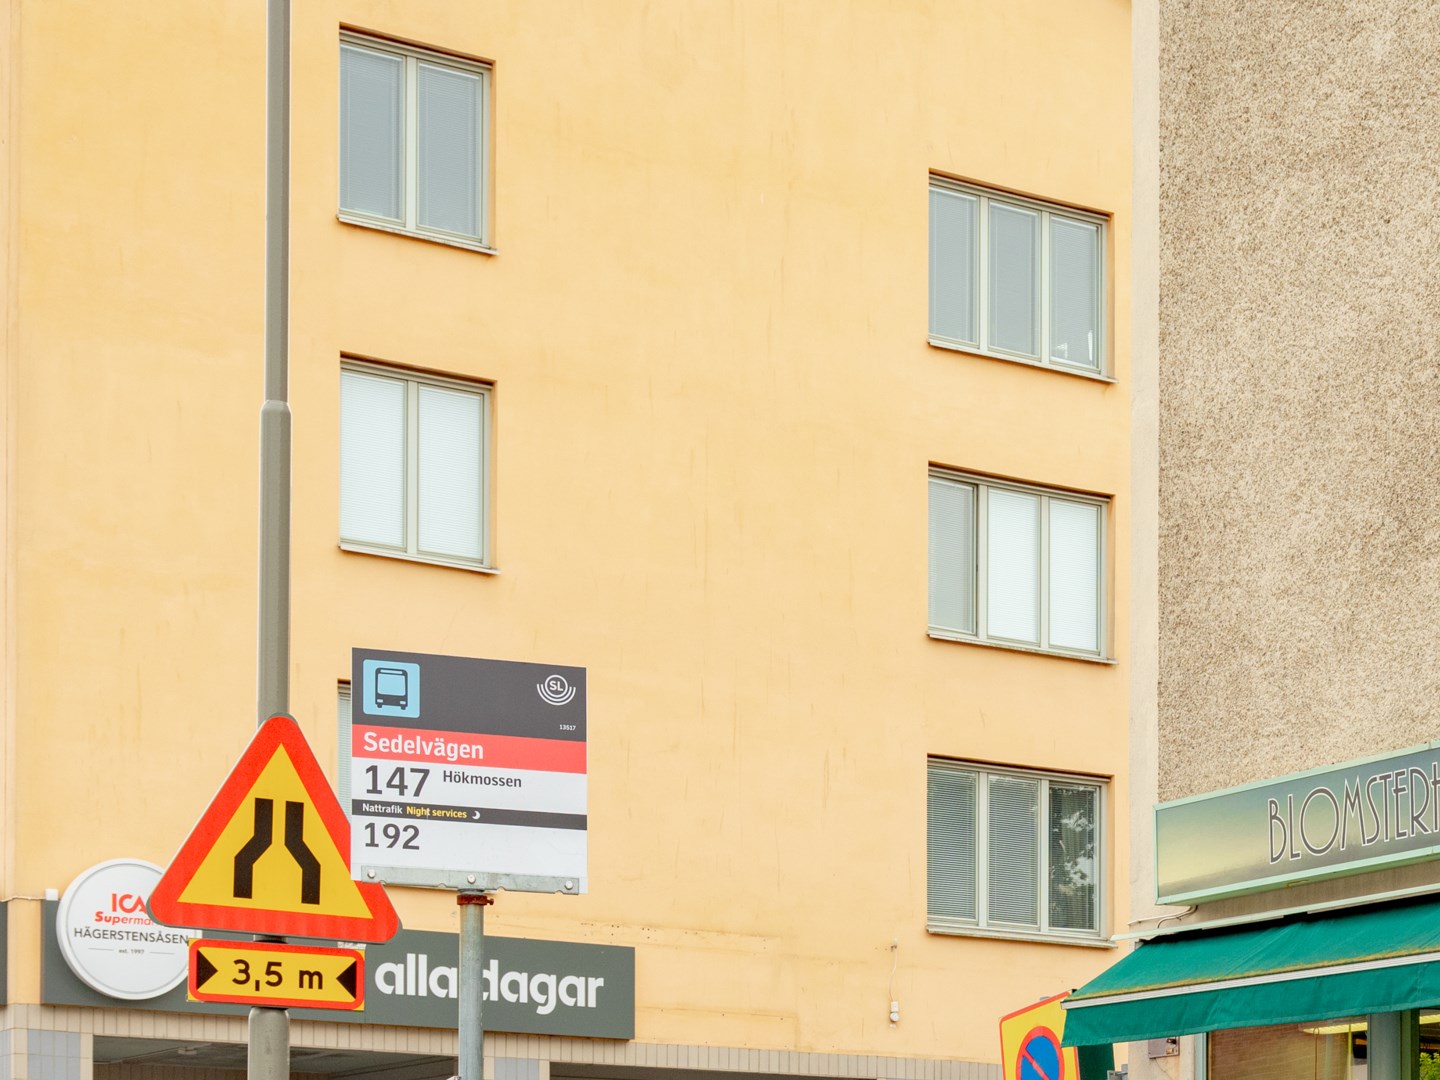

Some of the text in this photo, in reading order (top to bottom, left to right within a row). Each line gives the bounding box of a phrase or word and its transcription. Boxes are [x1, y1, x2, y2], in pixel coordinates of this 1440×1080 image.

[549, 680, 563, 692] SL
[363, 732, 484, 761] Sedelvägen
[365, 765, 430, 797] 147
[443, 770, 522, 788] Hökmossen
[362, 803, 467, 819] Nattrafik Night services
[364, 822, 420, 850] 192
[111, 893, 147, 914] ICA
[73, 926, 189, 945] HÄGERSTENSÅSEN
[232, 959, 323, 992] 3,5 m
[374, 953, 459, 998] alla
